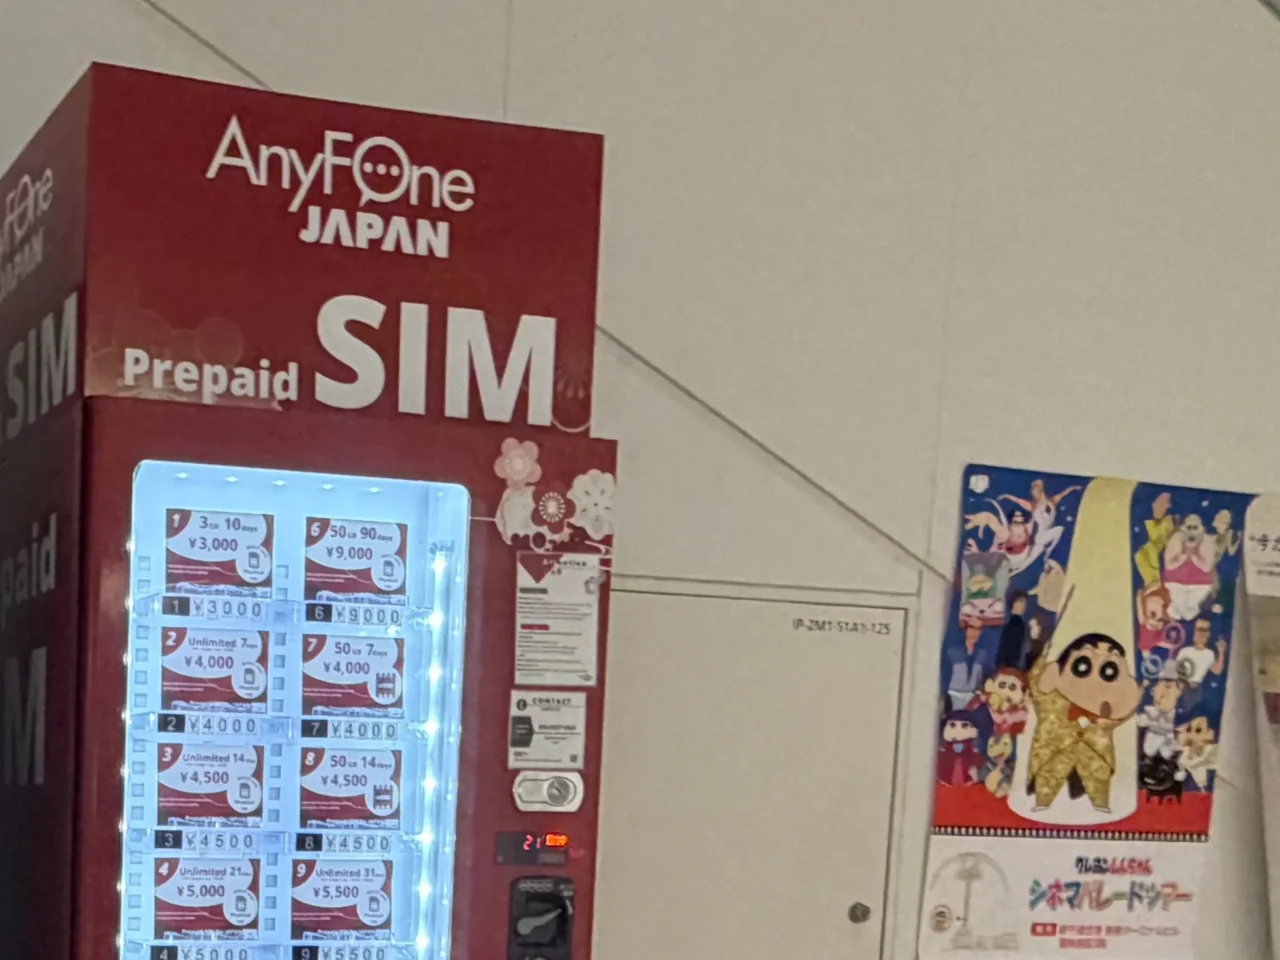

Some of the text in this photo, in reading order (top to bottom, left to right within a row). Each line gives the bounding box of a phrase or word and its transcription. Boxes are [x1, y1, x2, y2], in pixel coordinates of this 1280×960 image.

[298, 205, 449, 258] JAPAN
[6, 290, 78, 440] SIM
[123, 293, 558, 426] Prepaid SIM
[171, 513, 181, 528] 1
[188, 536, 239, 552] ¥3,000
[326, 546, 373, 561] ¥9,000
[172, 600, 180, 614] 1
[314, 606, 324, 620] 6
[165, 631, 177, 646] 2
[188, 637, 238, 648] Unlimited
[307, 638, 318, 652] 7
[184, 655, 234, 670] ¥4,000
[323, 660, 370, 676] ¥4,000
[167, 717, 177, 731] 2
[311, 722, 320, 735] 7
[162, 747, 173, 762] 3
[182, 753, 230, 764] Unlimited
[180, 771, 229, 786] ¥4,500
[321, 774, 368, 789] ¥4,500
[164, 833, 174, 847] 3
[304, 836, 314, 849] 8
[158, 862, 170, 876] 4
[179, 867, 227, 877] Unlimited
[296, 863, 307, 878] 9
[315, 868, 361, 878] Unlimited
[176, 884, 225, 900] ¥5,000
[313, 885, 360, 900] ¥5,500
